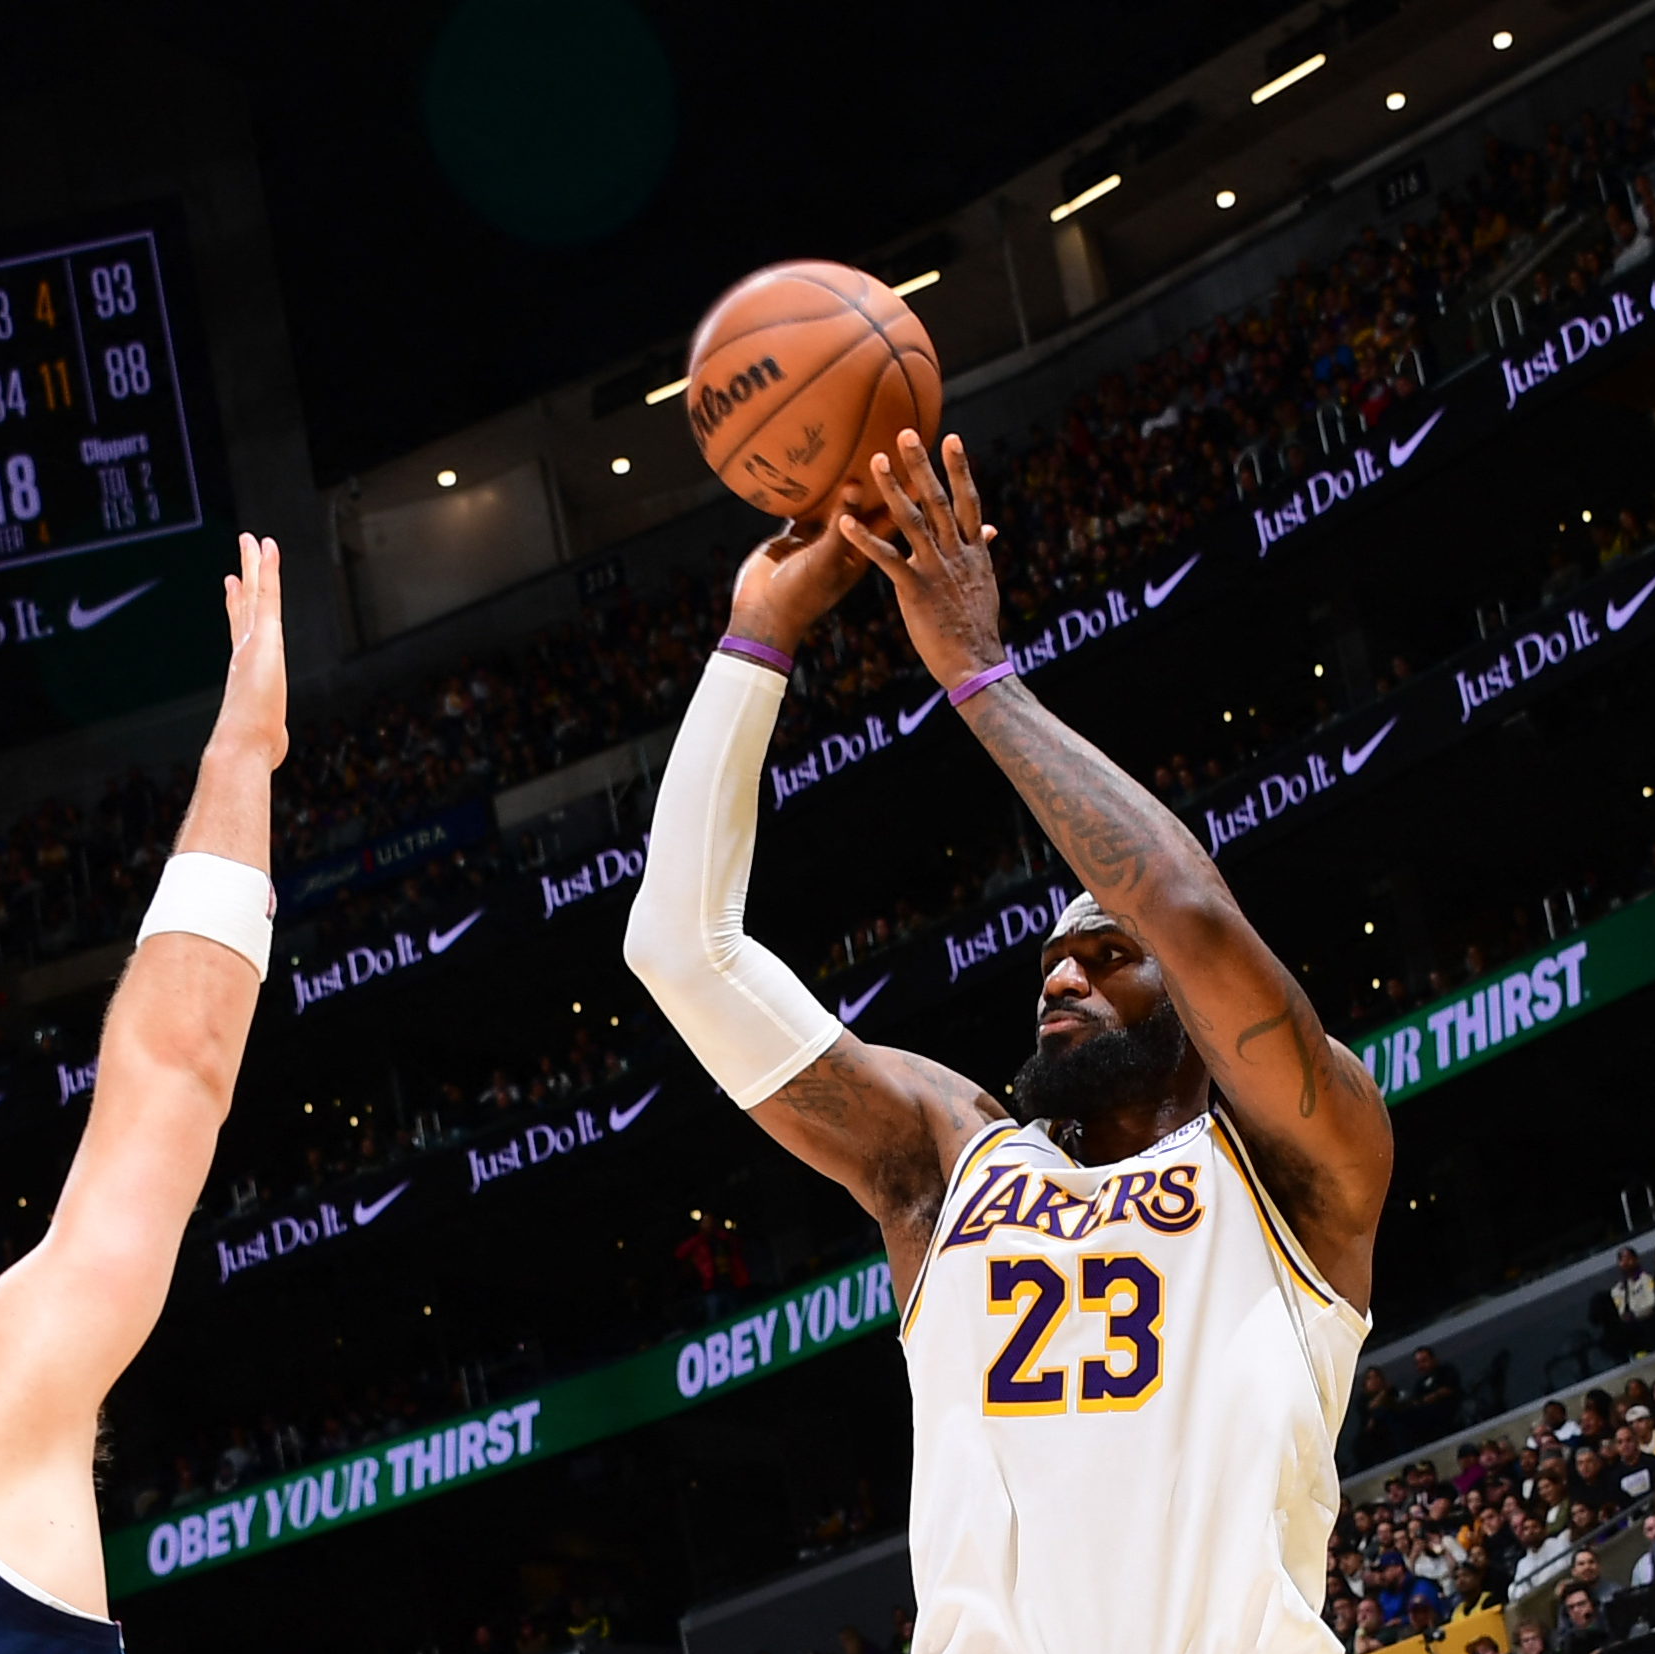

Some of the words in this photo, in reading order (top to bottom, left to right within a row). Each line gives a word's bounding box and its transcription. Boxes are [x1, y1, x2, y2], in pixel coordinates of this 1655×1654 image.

[35, 279, 56, 330] 4
[90, 260, 138, 319] 93
[39, 358, 72, 411] 11
[104, 341, 150, 400] 88
[1502, 341, 1559, 409] Just
[1560, 316, 1611, 363] Do
[1612, 294, 1643, 332] It.
[1254, 494, 1306, 556] Just
[1308, 470, 1354, 515] Do
[1355, 450, 1383, 487] It.
[12, 599, 54, 641] It.
[1059, 610, 1106, 651] Do
[1107, 591, 1137, 626] It.
[1456, 655, 1513, 722] Just
[1515, 633, 1567, 679] Do
[1568, 611, 1599, 651] It.
[771, 754, 820, 810] Just
[821, 734, 865, 774] Do
[866, 716, 893, 751] It.
[1206, 796, 1258, 857] Just
[1260, 775, 1307, 818] Do
[1307, 755, 1336, 792] It.
[376, 824, 447, 866] ULTRA
[542, 867, 593, 917] Just
[597, 850, 643, 887] Do
[293, 961, 344, 1013] Just
[347, 948, 393, 984] Do
[395, 934, 422, 966] It.
[946, 924, 997, 979] Just
[1001, 906, 1047, 945] Do
[1428, 942, 1586, 1068] THIRST
[218, 1233, 269, 1282] Just
[272, 1218, 318, 1254] Do
[320, 1204, 347, 1237] It.
[938, 1163, 1206, 1258] LAKERS
[677, 1309, 777, 1396] OBEY
[785, 1262, 891, 1353] YOUR
[982, 1251, 1165, 1417] 23
[149, 1496, 256, 1574] OBEY
[266, 1458, 378, 1537] YOUR
[386, 1401, 539, 1496] THIRST
